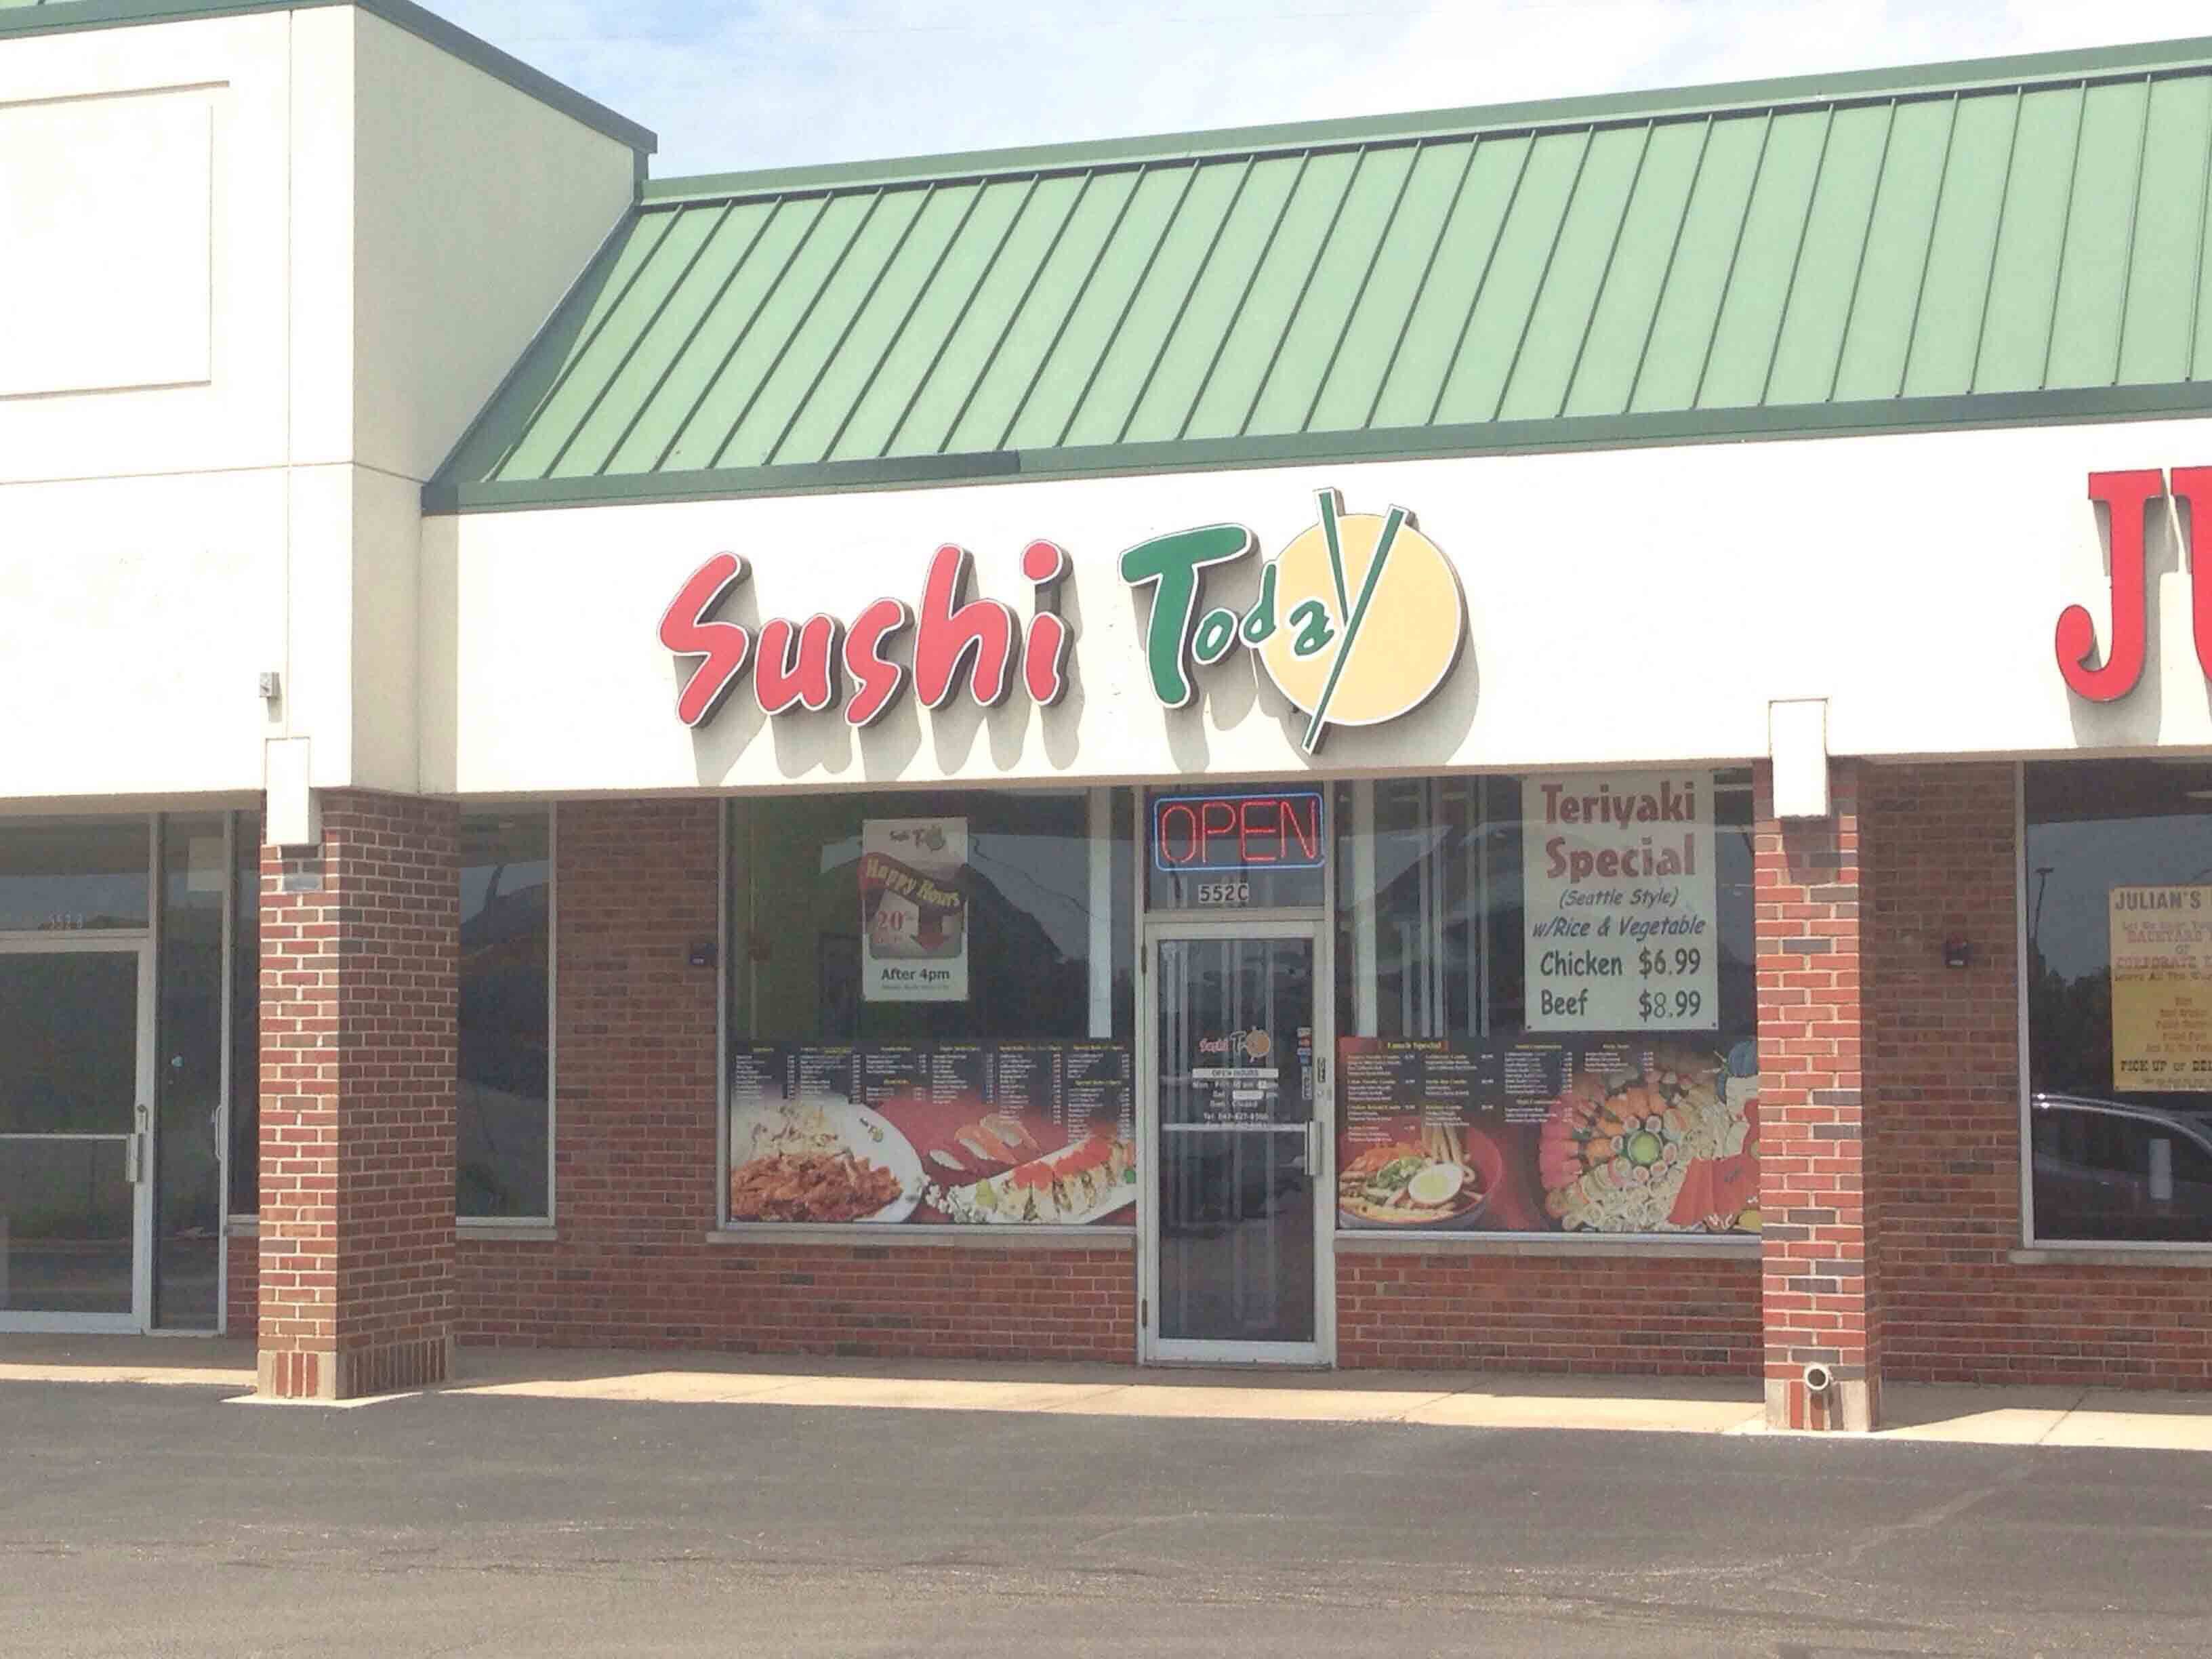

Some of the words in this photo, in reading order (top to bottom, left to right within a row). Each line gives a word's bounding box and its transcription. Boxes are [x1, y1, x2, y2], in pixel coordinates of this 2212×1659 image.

[658, 538, 1062, 726] Sushi
[1119, 487, 1410, 754] Today
[1541, 781, 1694, 830] Teriyaki
[1162, 800, 1316, 863] OPEN
[1546, 832, 1696, 883] Special
[866, 857, 916, 895] Happy
[1559, 888, 1622, 909] (Seattle
[1630, 887, 1679, 908] Style)
[2115, 890, 2202, 910] JULIAN'S
[1533, 916, 1590, 938] w/Rice
[1597, 916, 1611, 937] &
[1619, 914, 1706, 941] Vegetable
[882, 968, 916, 981] After
[920, 968, 949, 983] 4pm
[1540, 949, 1622, 976] Chicken
[1639, 947, 1701, 979] $6.99
[1541, 989, 1588, 1015] Beef
[1639, 989, 1701, 1021] $8.99
